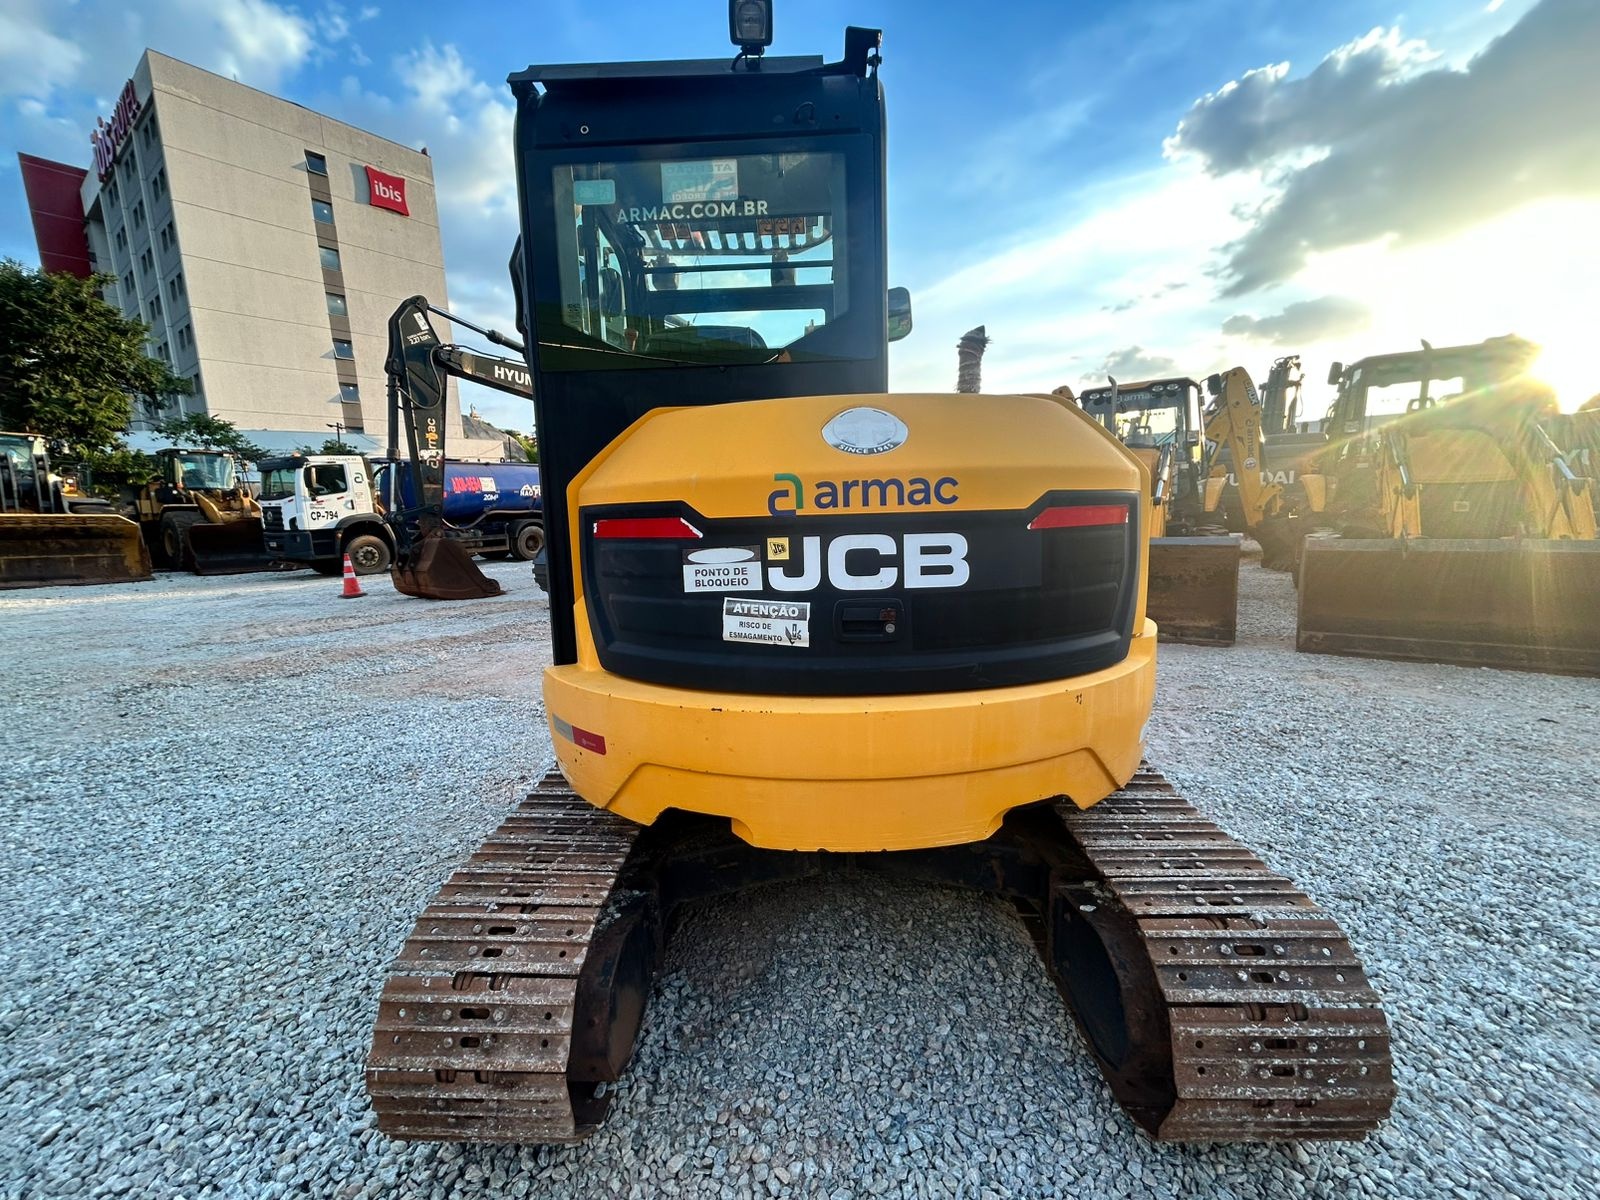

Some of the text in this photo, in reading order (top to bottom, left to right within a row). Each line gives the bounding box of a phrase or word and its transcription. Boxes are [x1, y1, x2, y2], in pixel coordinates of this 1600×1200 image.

[374, 180, 402, 202] ibis
[617, 200, 769, 223] ARMAC.COM.BR
[838, 443, 894, 455] SINCE 1945
[814, 477, 959, 509] armac
[310, 510, 339, 521] CP-794
[767, 532, 970, 592] JCB JCB
[694, 567, 748, 577] PONTO DE
[694, 577, 749, 588] BLOQUEIO
[733, 602, 799, 619] ATENÇÃO
[738, 621, 772, 630] RISCO DE
[728, 631, 783, 642] ESMAGAMENTO
